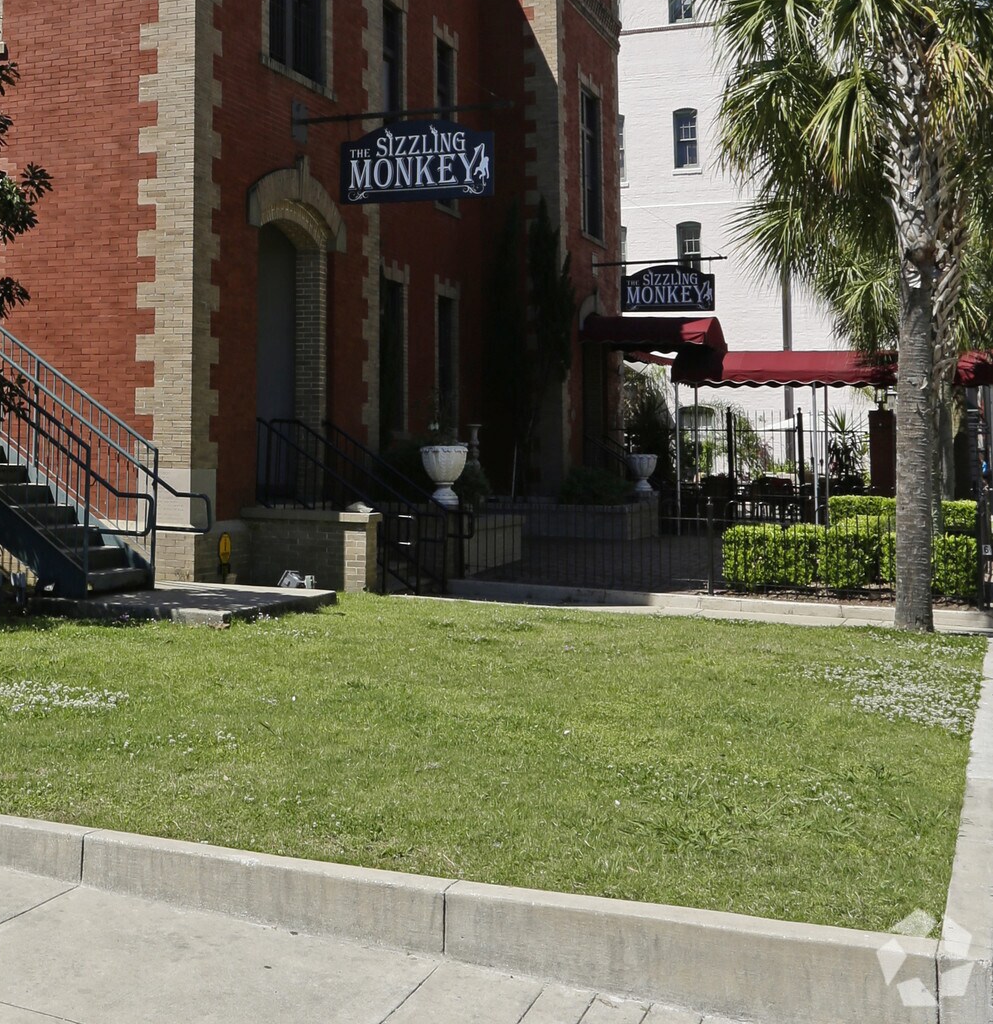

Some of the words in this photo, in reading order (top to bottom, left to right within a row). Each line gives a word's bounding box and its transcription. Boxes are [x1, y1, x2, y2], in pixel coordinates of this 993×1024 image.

[349, 148, 371, 158] THE
[375, 126, 466, 157] SIZZLING
[348, 144, 483, 191] MONKEY
[643, 269, 698, 286] SIZZLING
[626, 281, 708, 303] MONKEY
